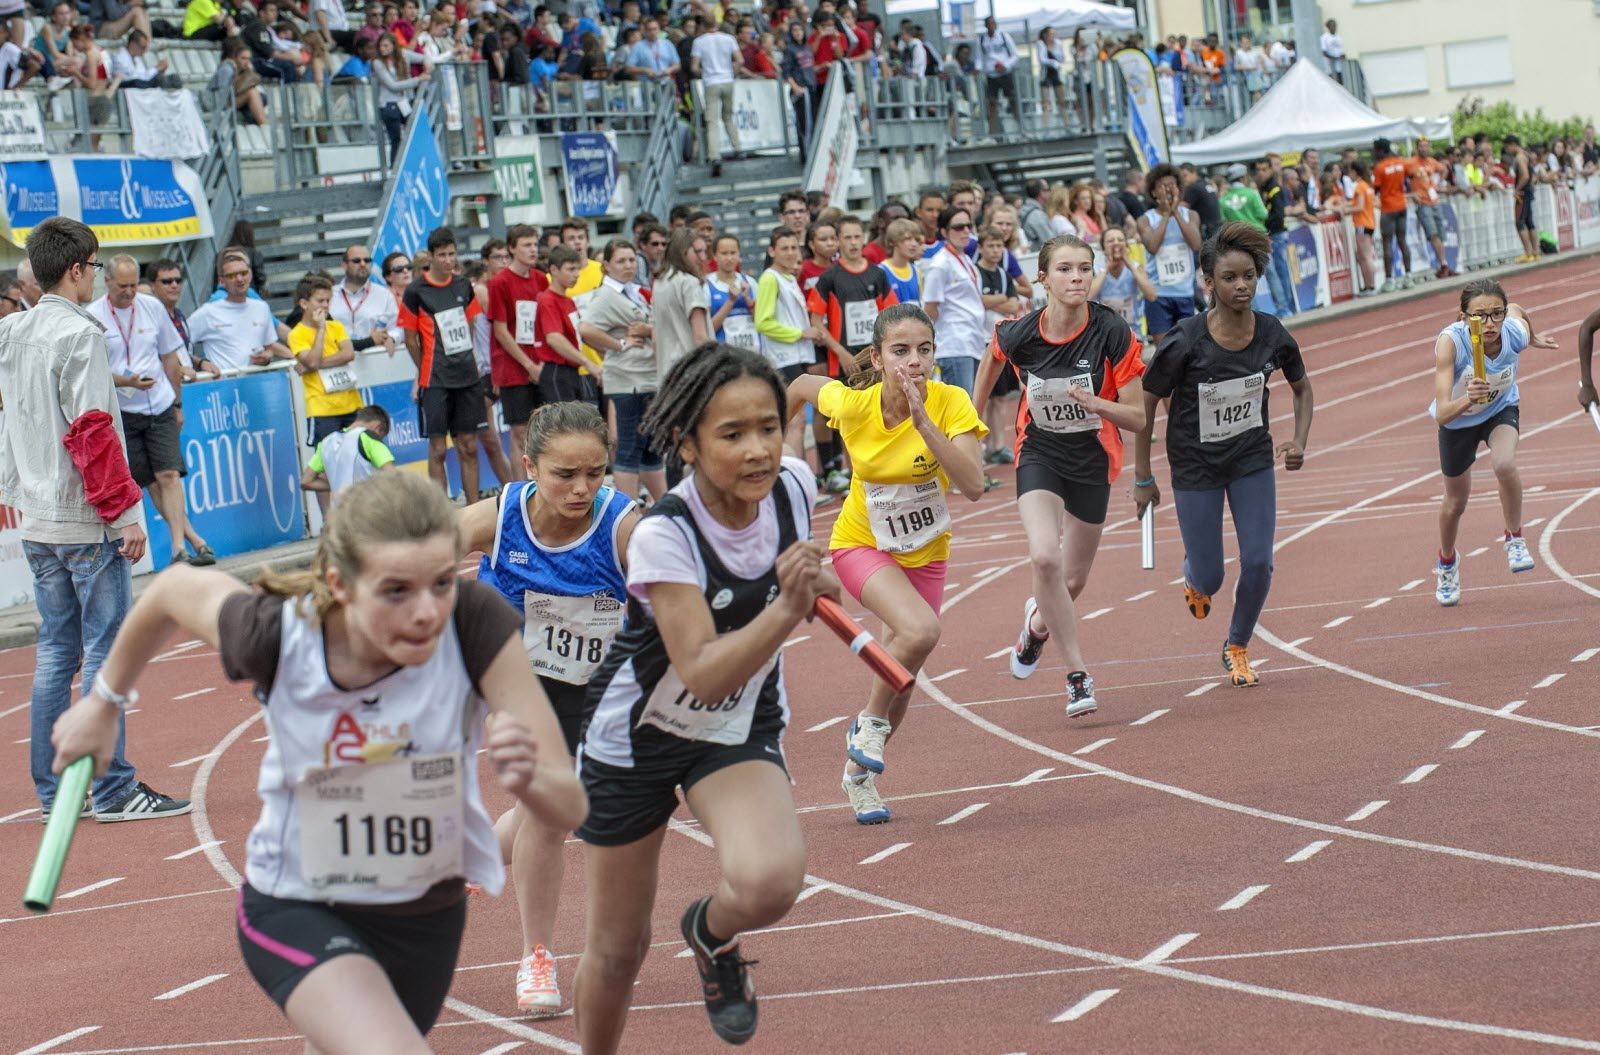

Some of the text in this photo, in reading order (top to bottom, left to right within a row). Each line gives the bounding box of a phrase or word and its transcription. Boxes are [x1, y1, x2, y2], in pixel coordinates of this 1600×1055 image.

[141, 185, 190, 209] MOSELLE
[494, 162, 533, 204] MAIF
[200, 388, 249, 433] ville de
[1042, 403, 1086, 422] 1236
[1213, 401, 1252, 427] 1422
[884, 507, 935, 538] 1199
[508, 557, 529, 565] SPORT
[545, 625, 603, 664] 1318
[334, 813, 432, 856] 1169
